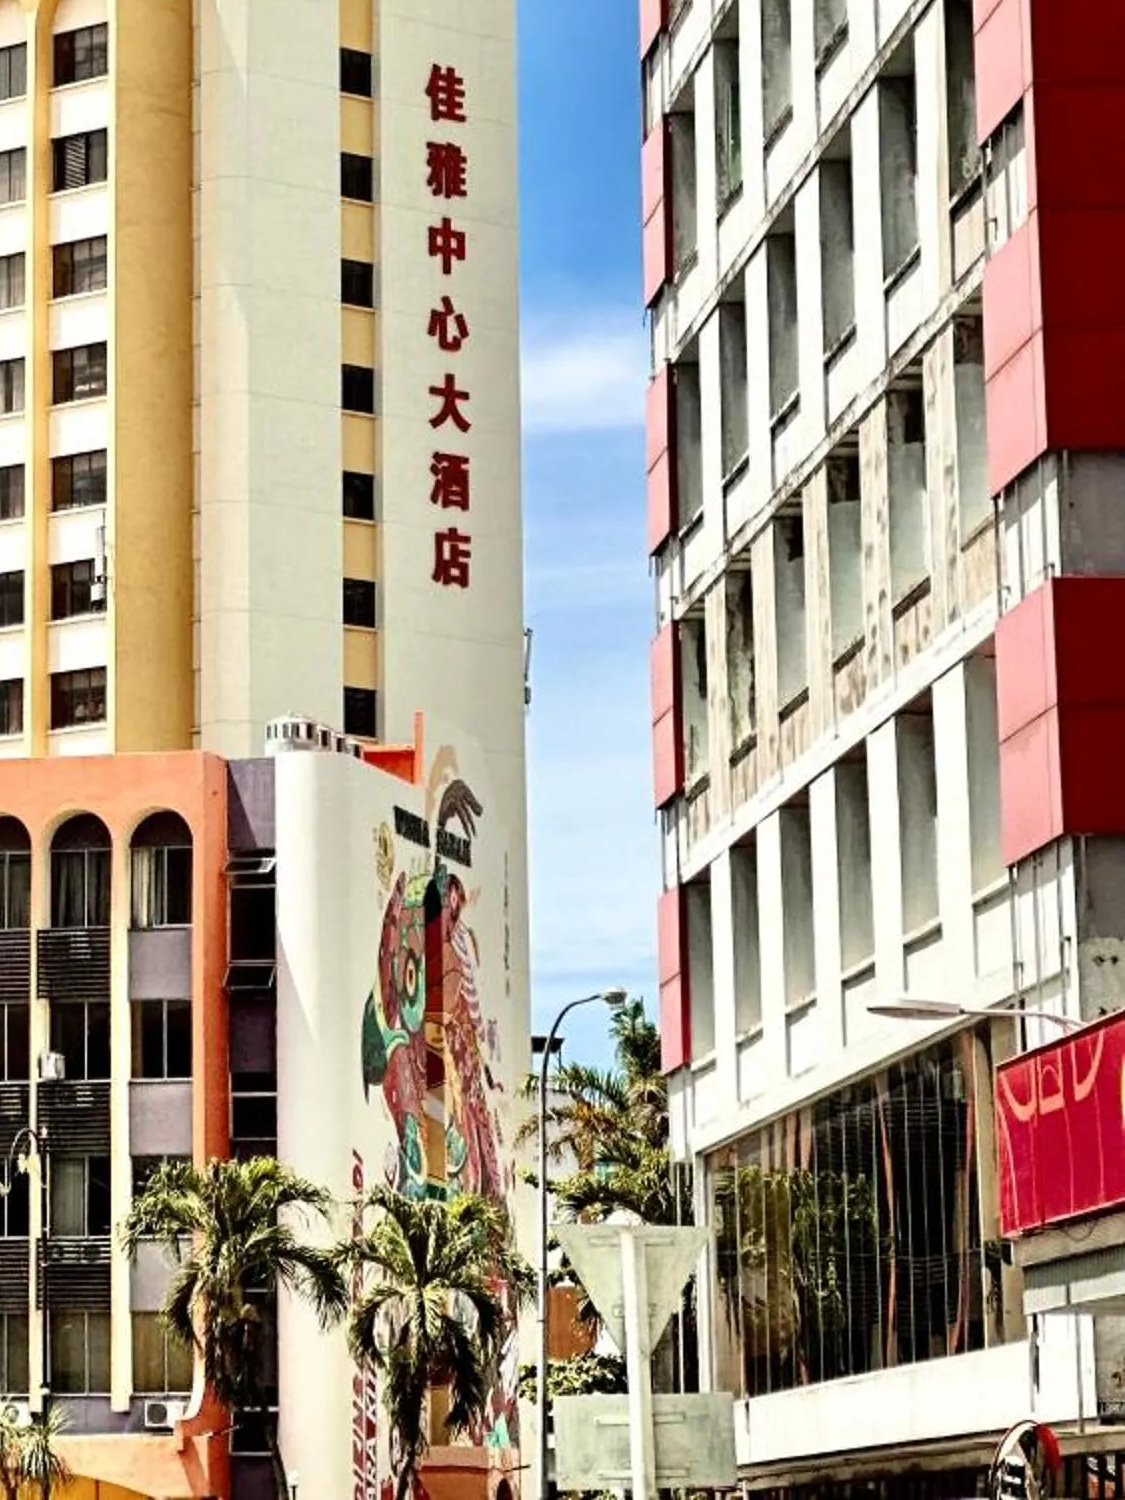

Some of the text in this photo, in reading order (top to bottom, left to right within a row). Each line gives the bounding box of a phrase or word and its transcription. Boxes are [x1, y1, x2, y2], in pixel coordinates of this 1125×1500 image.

[425, 63, 472, 588] 佳雅中心大酒店
